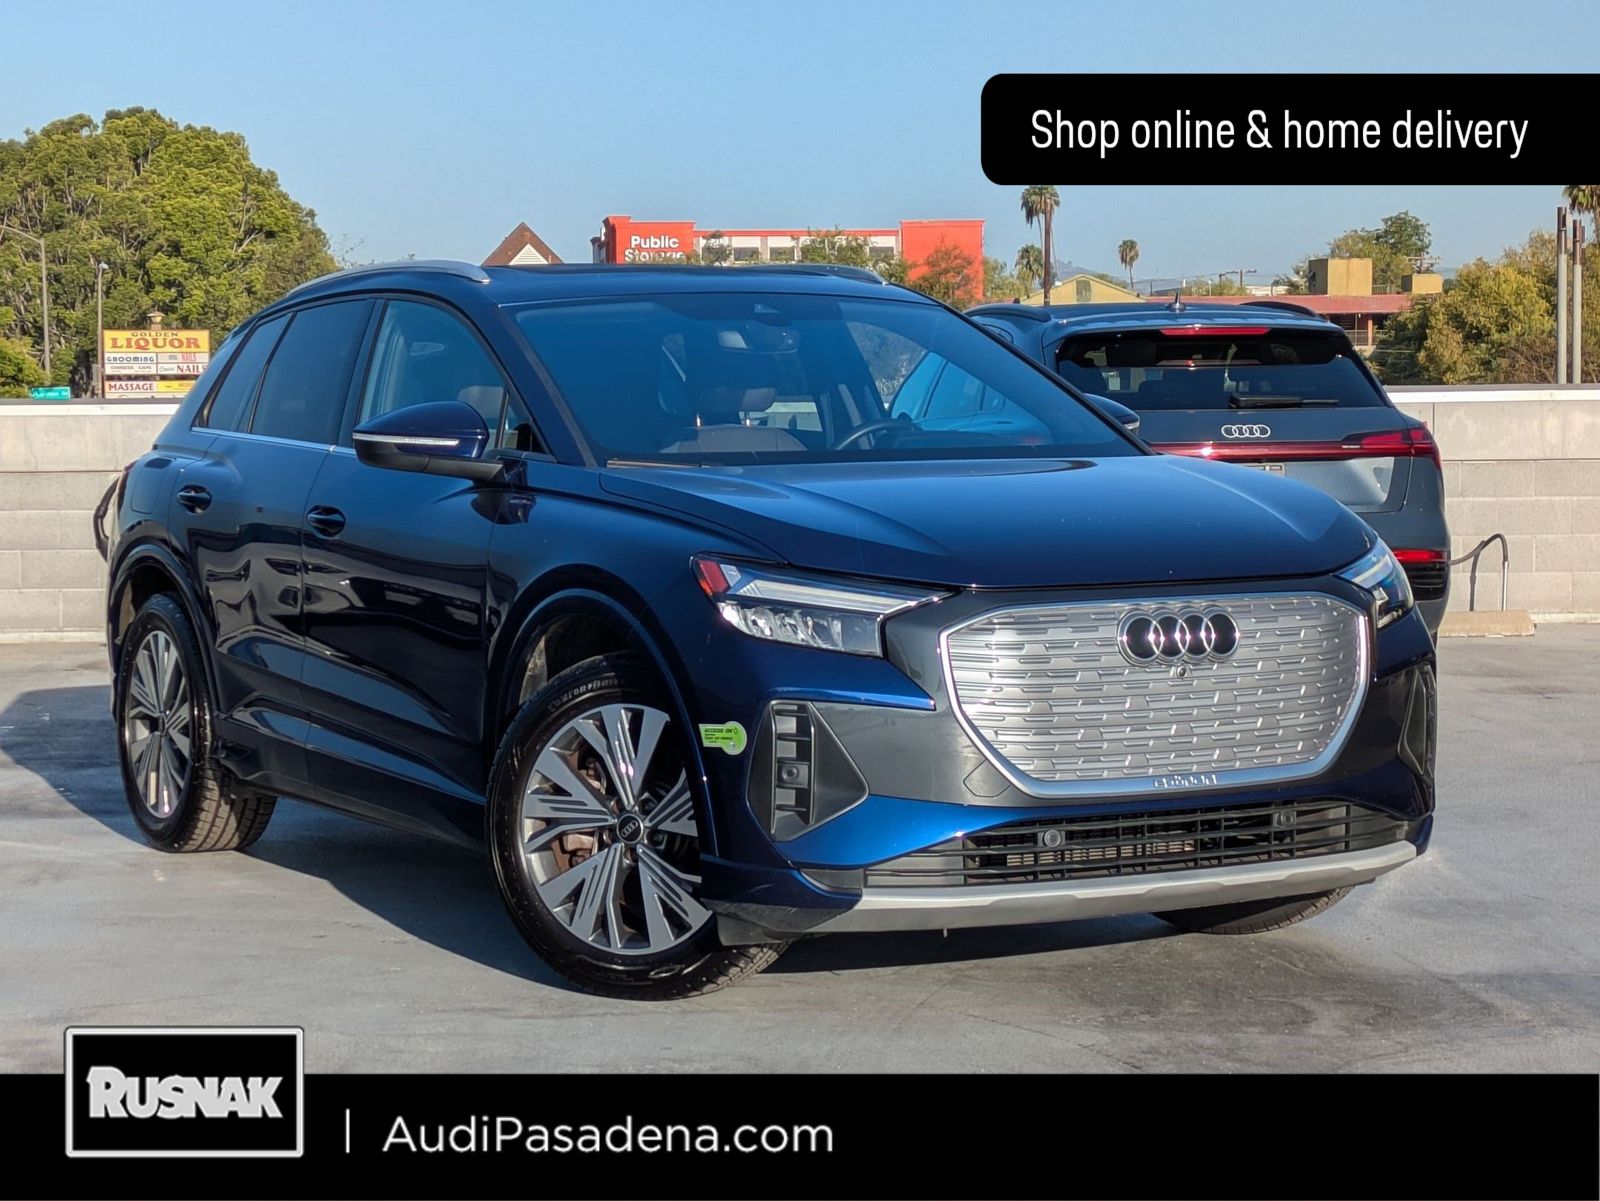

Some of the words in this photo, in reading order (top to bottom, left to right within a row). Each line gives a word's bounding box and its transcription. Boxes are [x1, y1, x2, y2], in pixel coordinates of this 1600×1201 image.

[630, 235, 679, 249] Public
[110, 337, 201, 350] LIQUOR
[108, 383, 154, 391] MASSAGE
